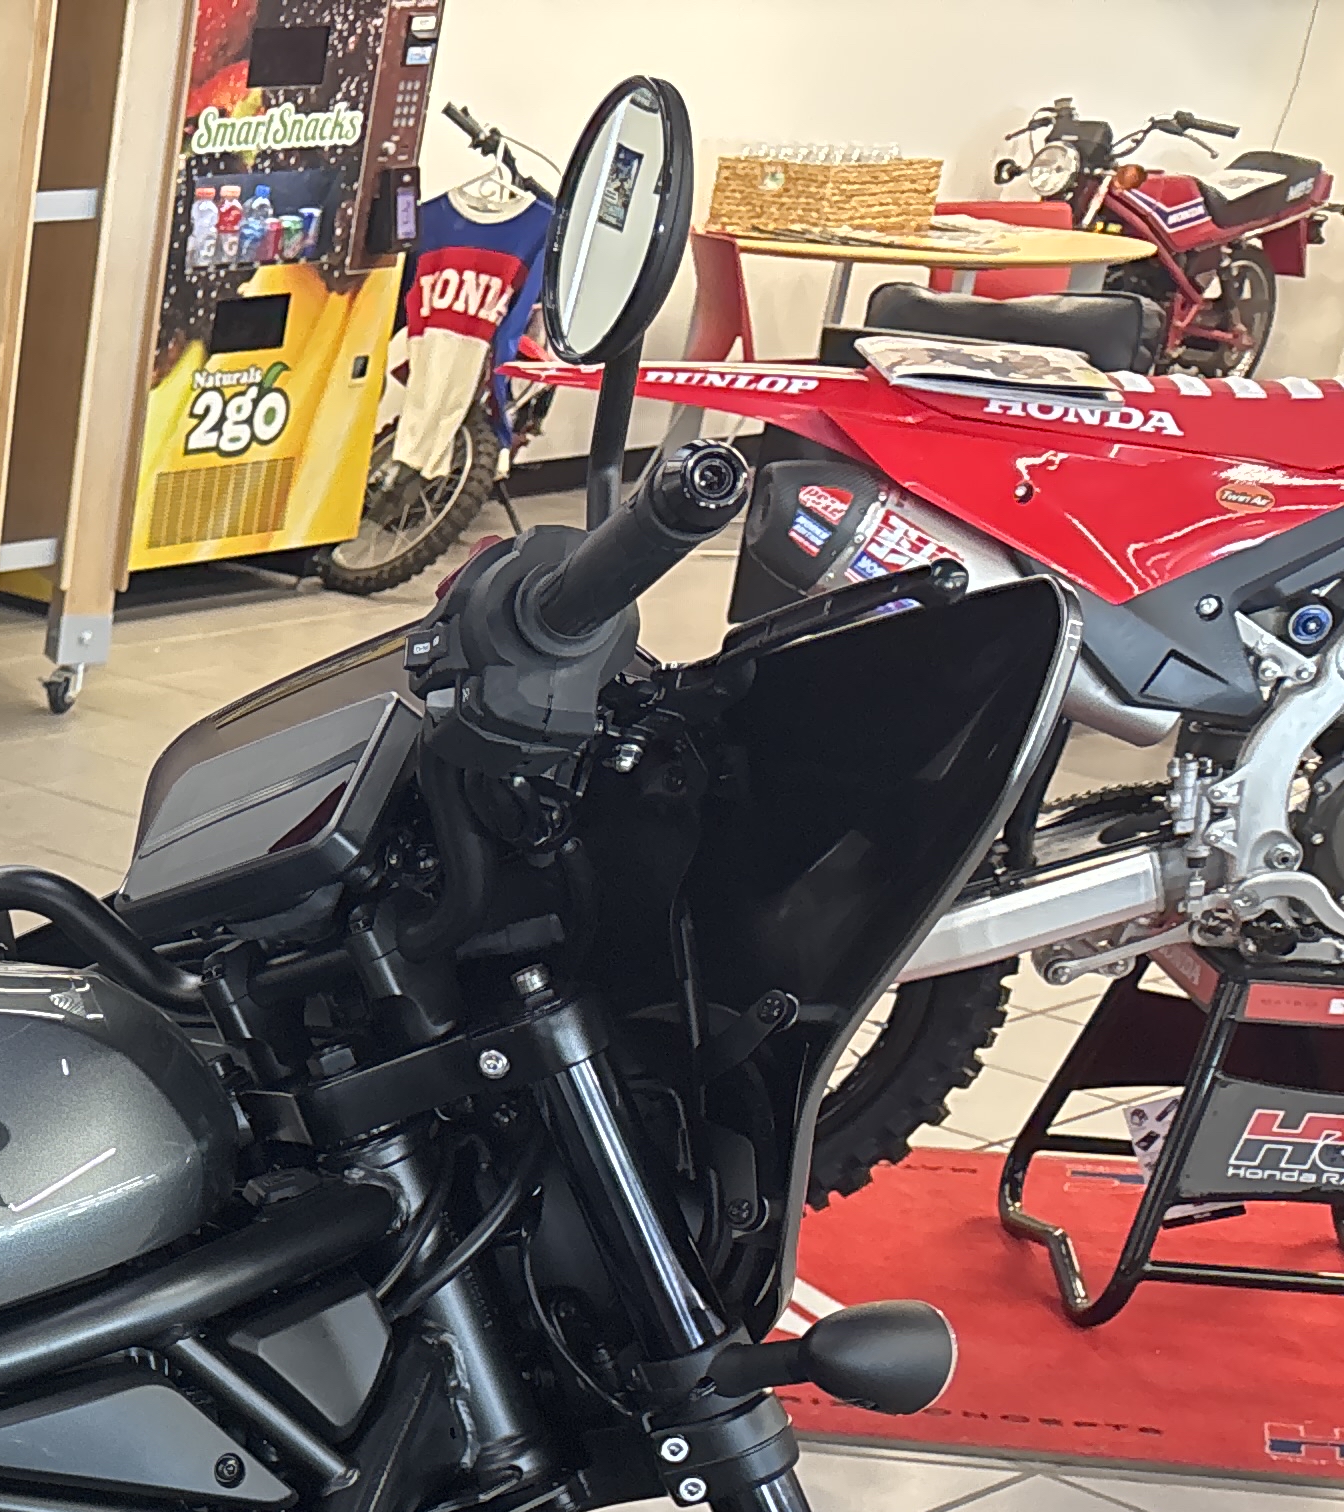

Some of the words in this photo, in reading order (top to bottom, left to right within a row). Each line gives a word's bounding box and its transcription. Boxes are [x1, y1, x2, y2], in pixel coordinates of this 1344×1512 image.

[196, 103, 359, 149] SmartSnacks
[644, 370, 819, 395] DUNLOP
[184, 383, 290, 457] 2go
[983, 399, 1185, 437] HONDA
[1220, 489, 1250, 504] Twin
[1227, 1165, 1317, 1185] Honda
